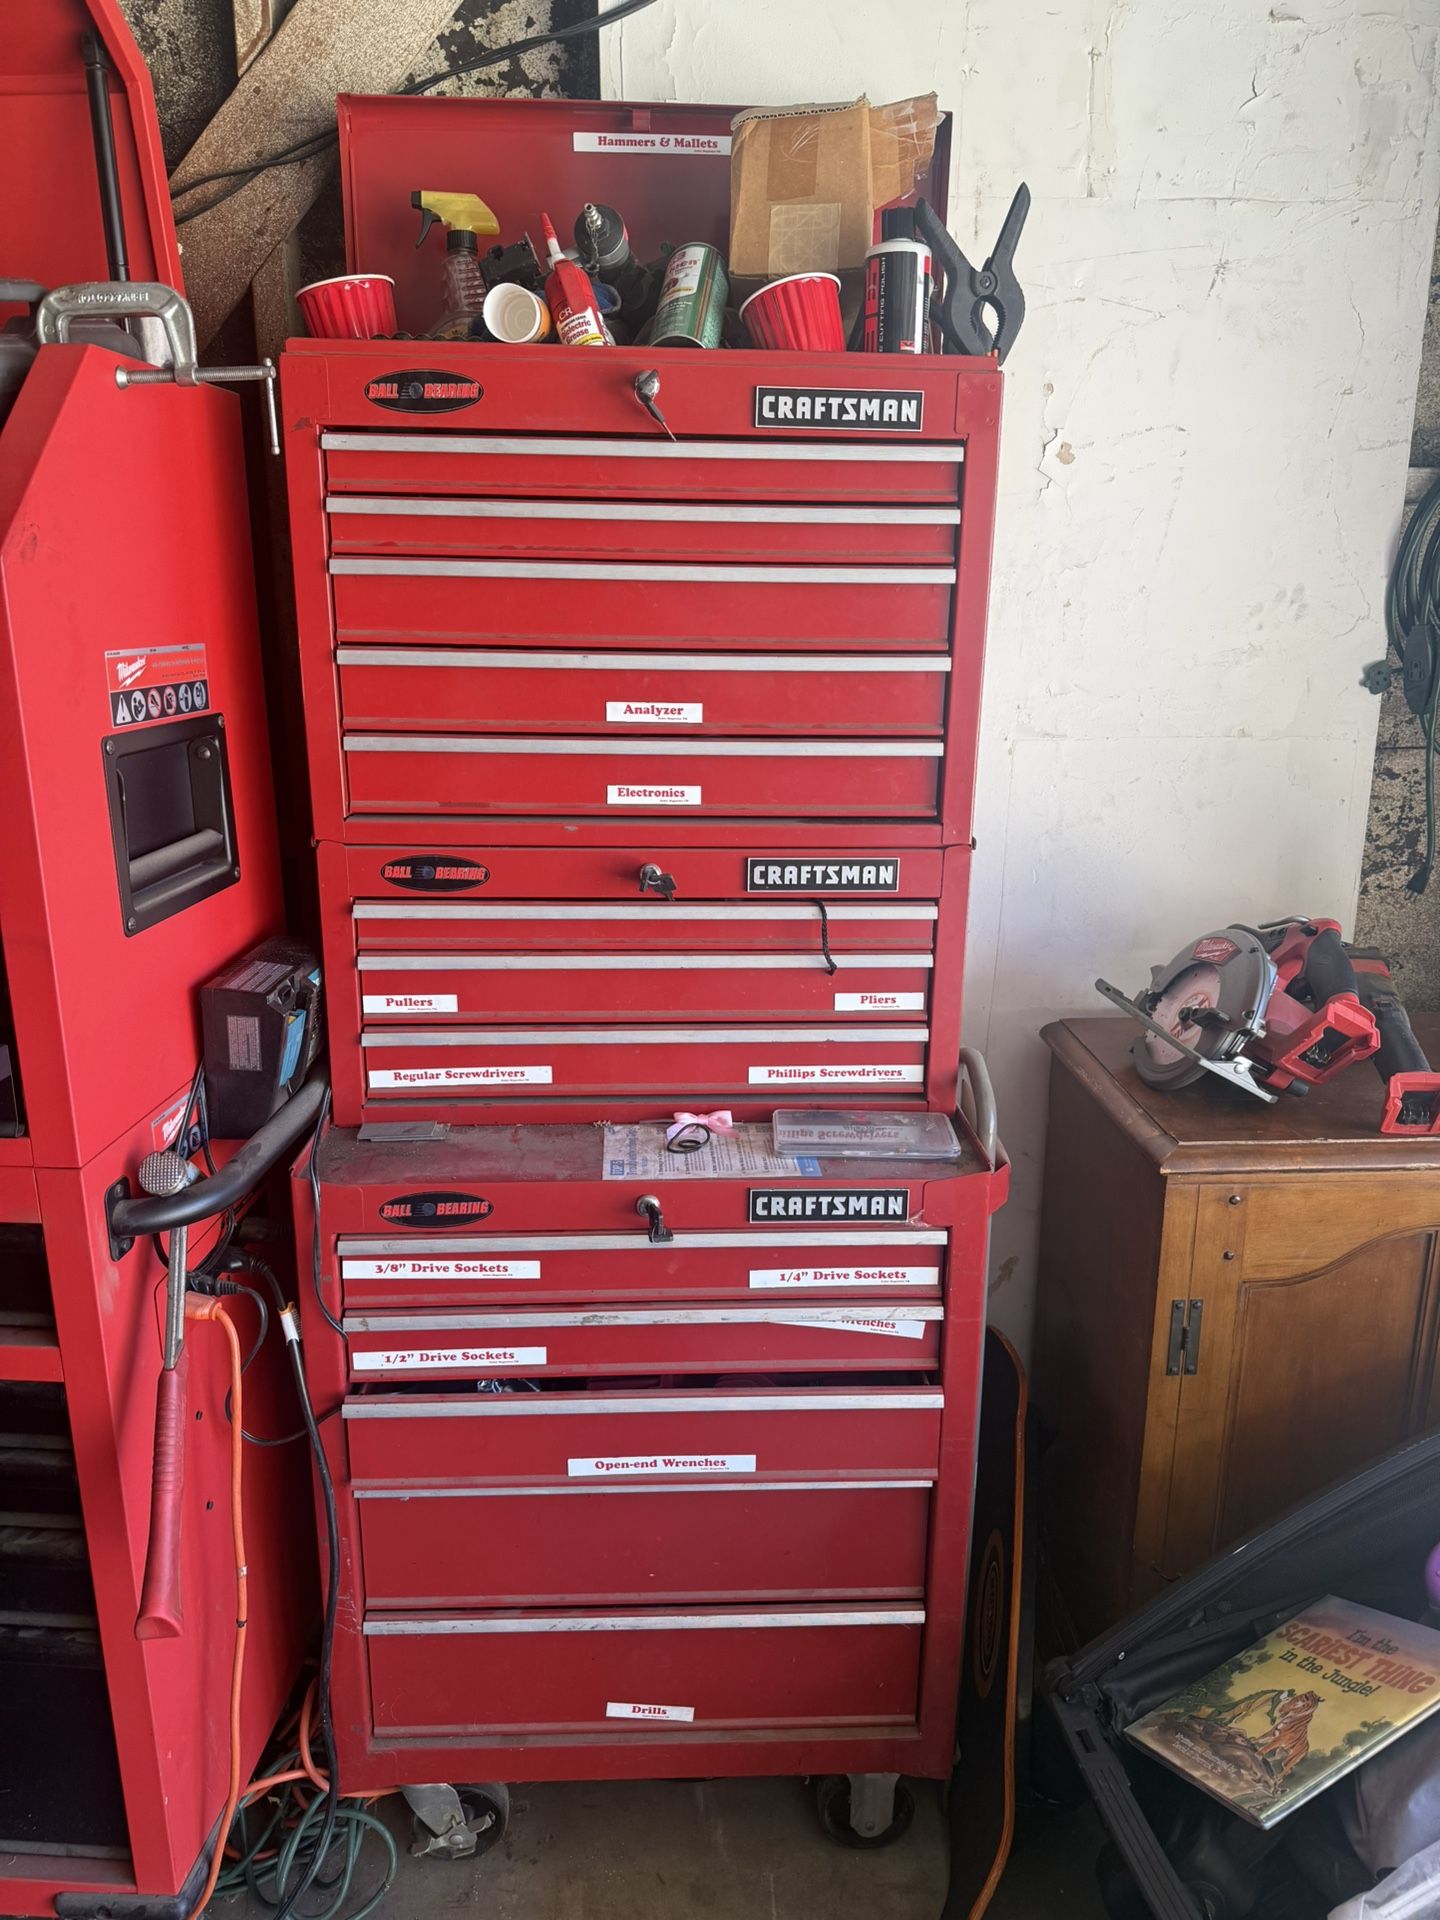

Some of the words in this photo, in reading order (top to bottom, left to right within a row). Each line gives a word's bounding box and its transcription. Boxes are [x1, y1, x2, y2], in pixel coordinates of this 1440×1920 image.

[597, 136, 656, 147] Hammers
[659, 137, 671, 148] &
[673, 138, 718, 149] Mallets
[367, 383, 399, 399] BALL
[423, 382, 481, 399] BEARING
[762, 395, 918, 422] CRAFTSMAN
[623, 704, 684, 717] Analyzer
[617, 787, 686, 798] Electronics
[383, 865, 412, 879] BALL
[434, 866, 487, 881] BEARING
[753, 865, 894, 885] CRAFTSMAN
[385, 997, 433, 1007] Pullers
[859, 995, 897, 1004] Pliers
[393, 1070, 442, 1083] Regular
[444, 1068, 526, 1079] Screwdrivers
[767, 1068, 816, 1080] Phillips
[819, 1067, 903, 1077] Screwdrivers
[382, 1203, 413, 1217] BALL
[436, 1200, 490, 1216] BEARING
[755, 1196, 904, 1216] CRAFTSMAN
[411, 1263, 450, 1273] Drive
[454, 1263, 509, 1273] Sockets
[813, 1271, 850, 1281] Drive
[854, 1270, 907, 1280] Sockets
[419, 1352, 458, 1362] Drive
[461, 1351, 515, 1361] Sockets
[594, 1458, 658, 1471] Open-end
[662, 1458, 727, 1468] Wrenches
[1346, 1628, 1371, 1646] I'm
[1371, 1637, 1400, 1655] the
[1279, 1647, 1297, 1663] in
[1296, 1655, 1324, 1674] the
[1321, 1669, 1382, 1698] Jungle!
[631, 1705, 668, 1715] Drills
